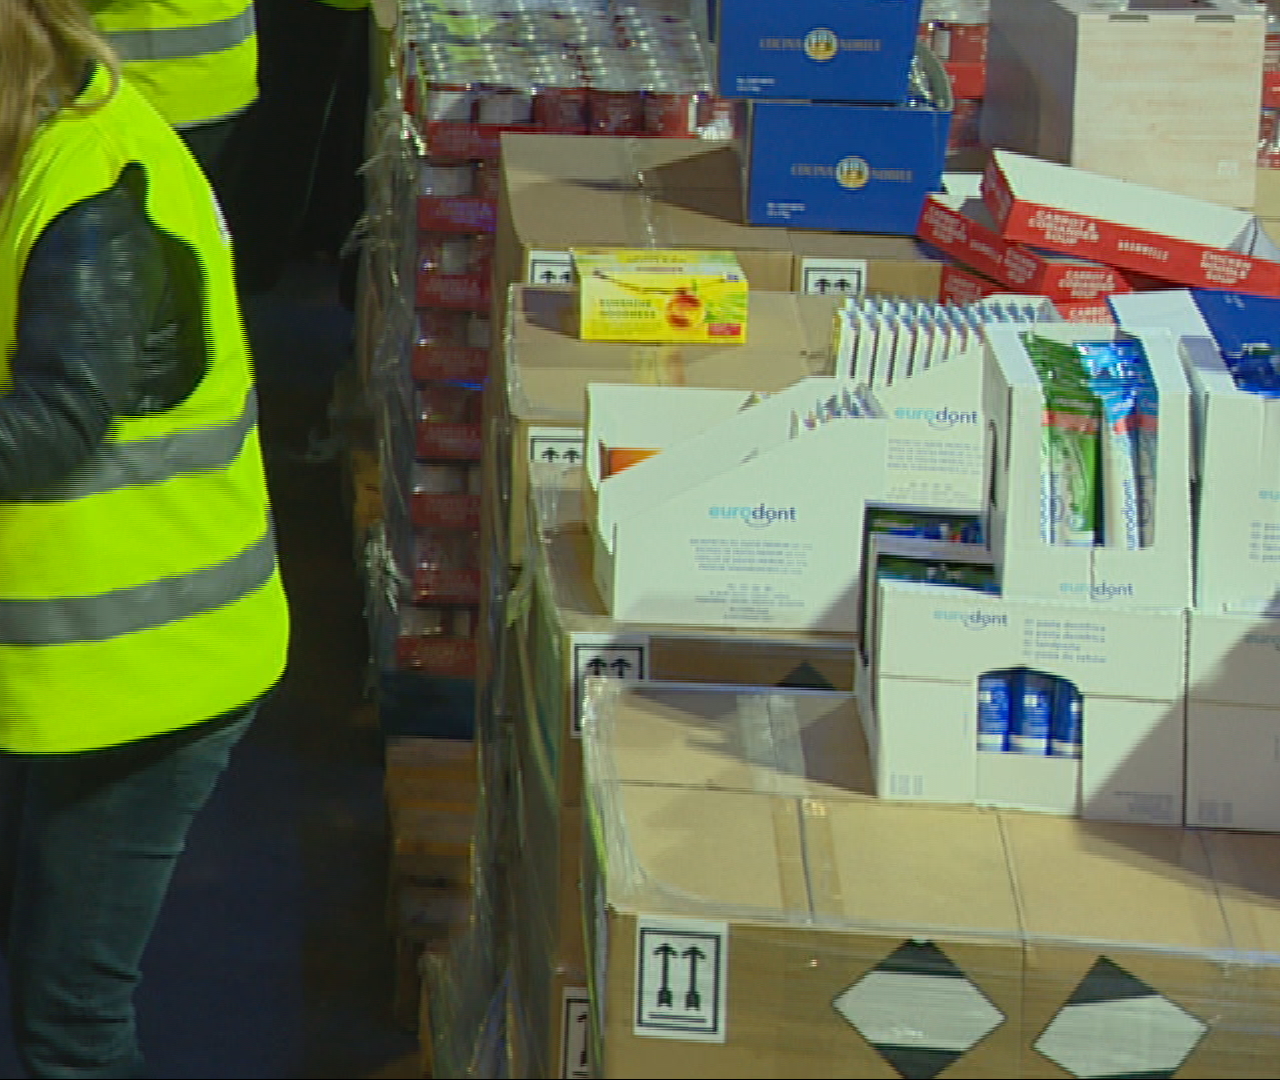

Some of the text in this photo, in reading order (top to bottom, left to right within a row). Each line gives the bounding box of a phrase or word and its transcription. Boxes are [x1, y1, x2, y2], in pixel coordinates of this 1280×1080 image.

[894, 406, 978, 424] eurodont
[708, 503, 798, 523] eurodont
[1122, 477, 1138, 549] urodont
[1059, 581, 1134, 597] eurodont
[933, 609, 1009, 627] eurodont
